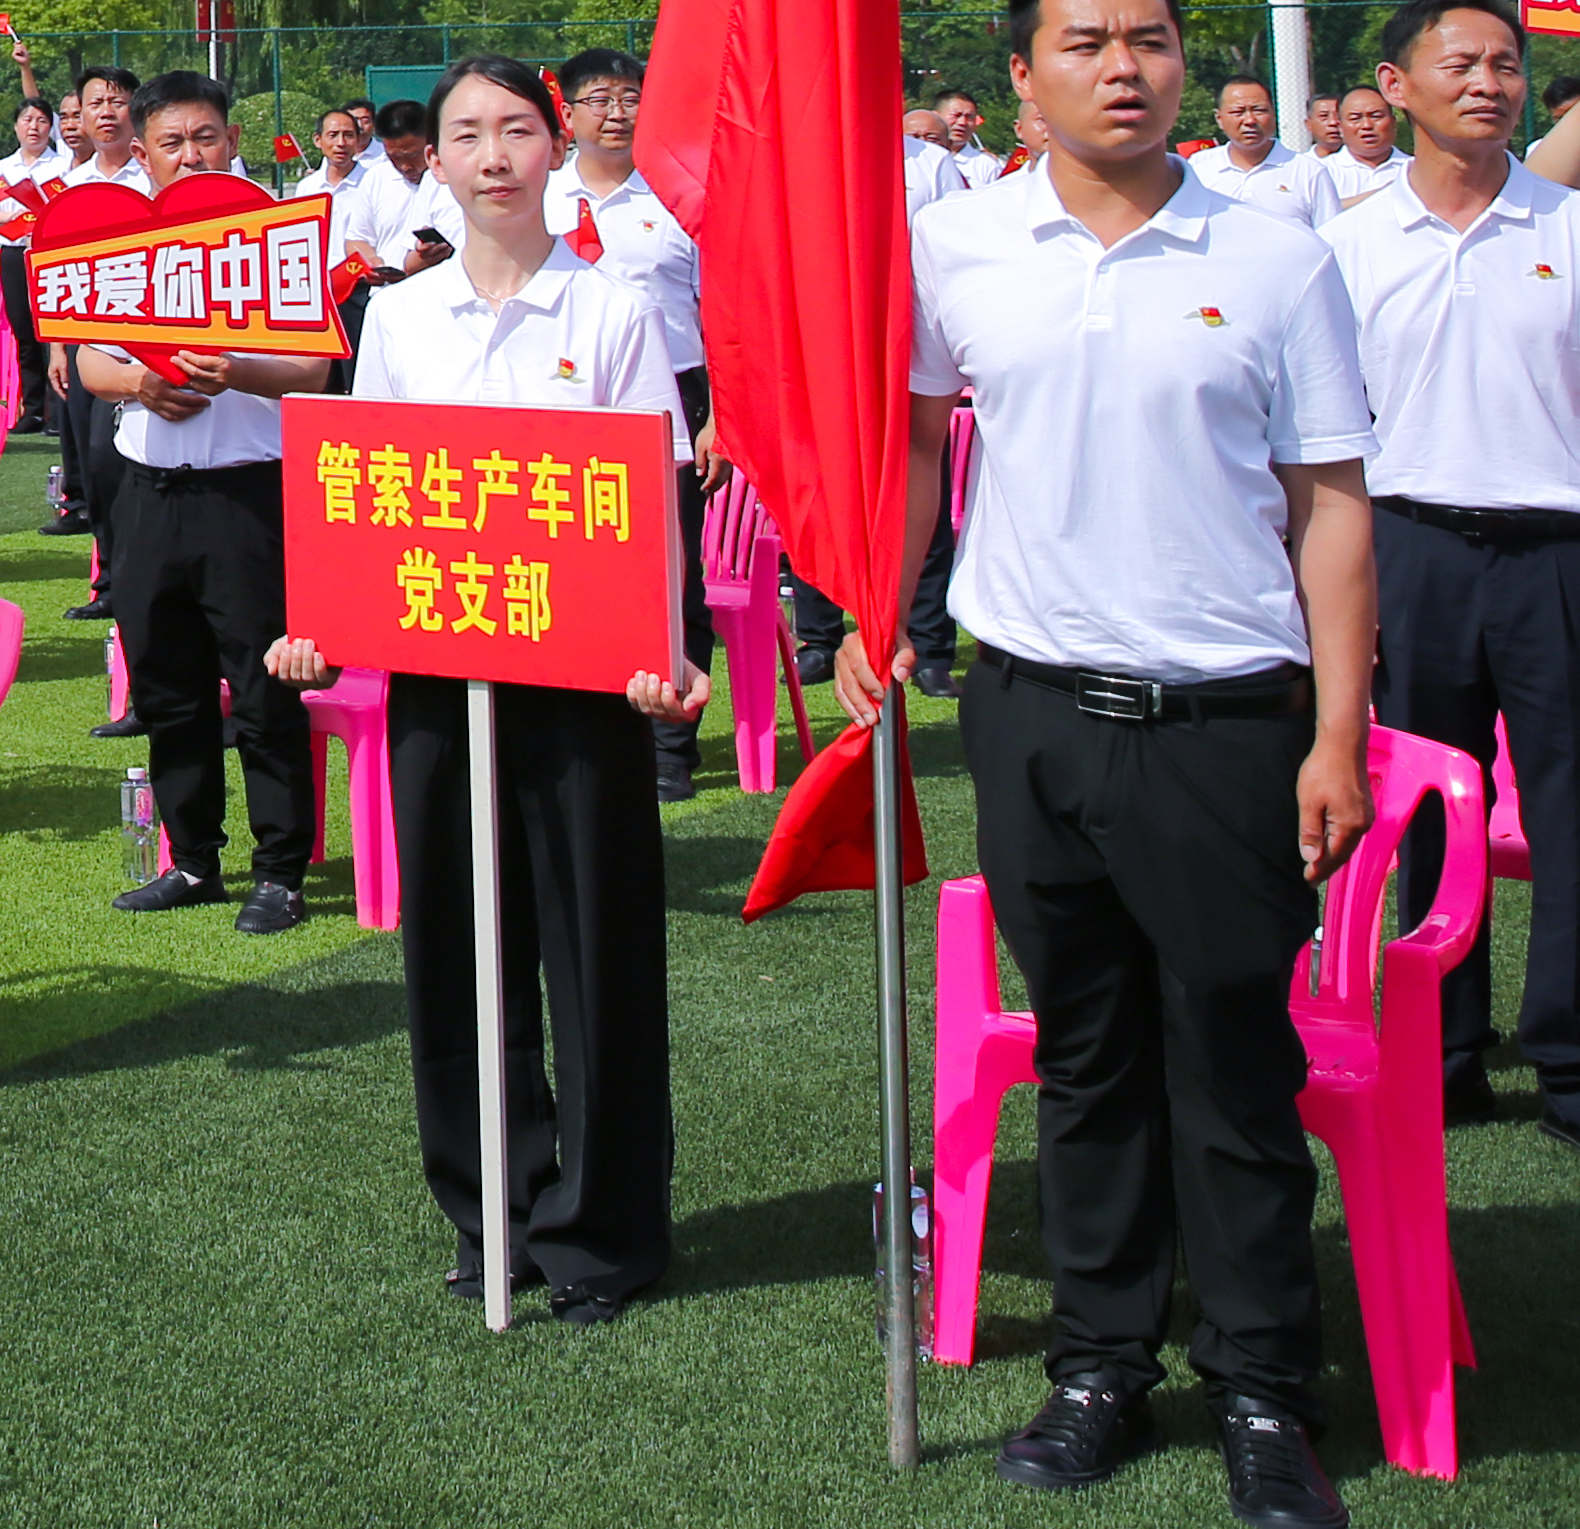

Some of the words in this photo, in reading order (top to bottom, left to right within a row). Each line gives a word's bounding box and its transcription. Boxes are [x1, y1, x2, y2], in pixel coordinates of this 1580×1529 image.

[37, 220, 324, 322] 我爱你中国
[316, 440, 630, 542] 管索生产车间
[396, 546, 552, 642] 党支部
